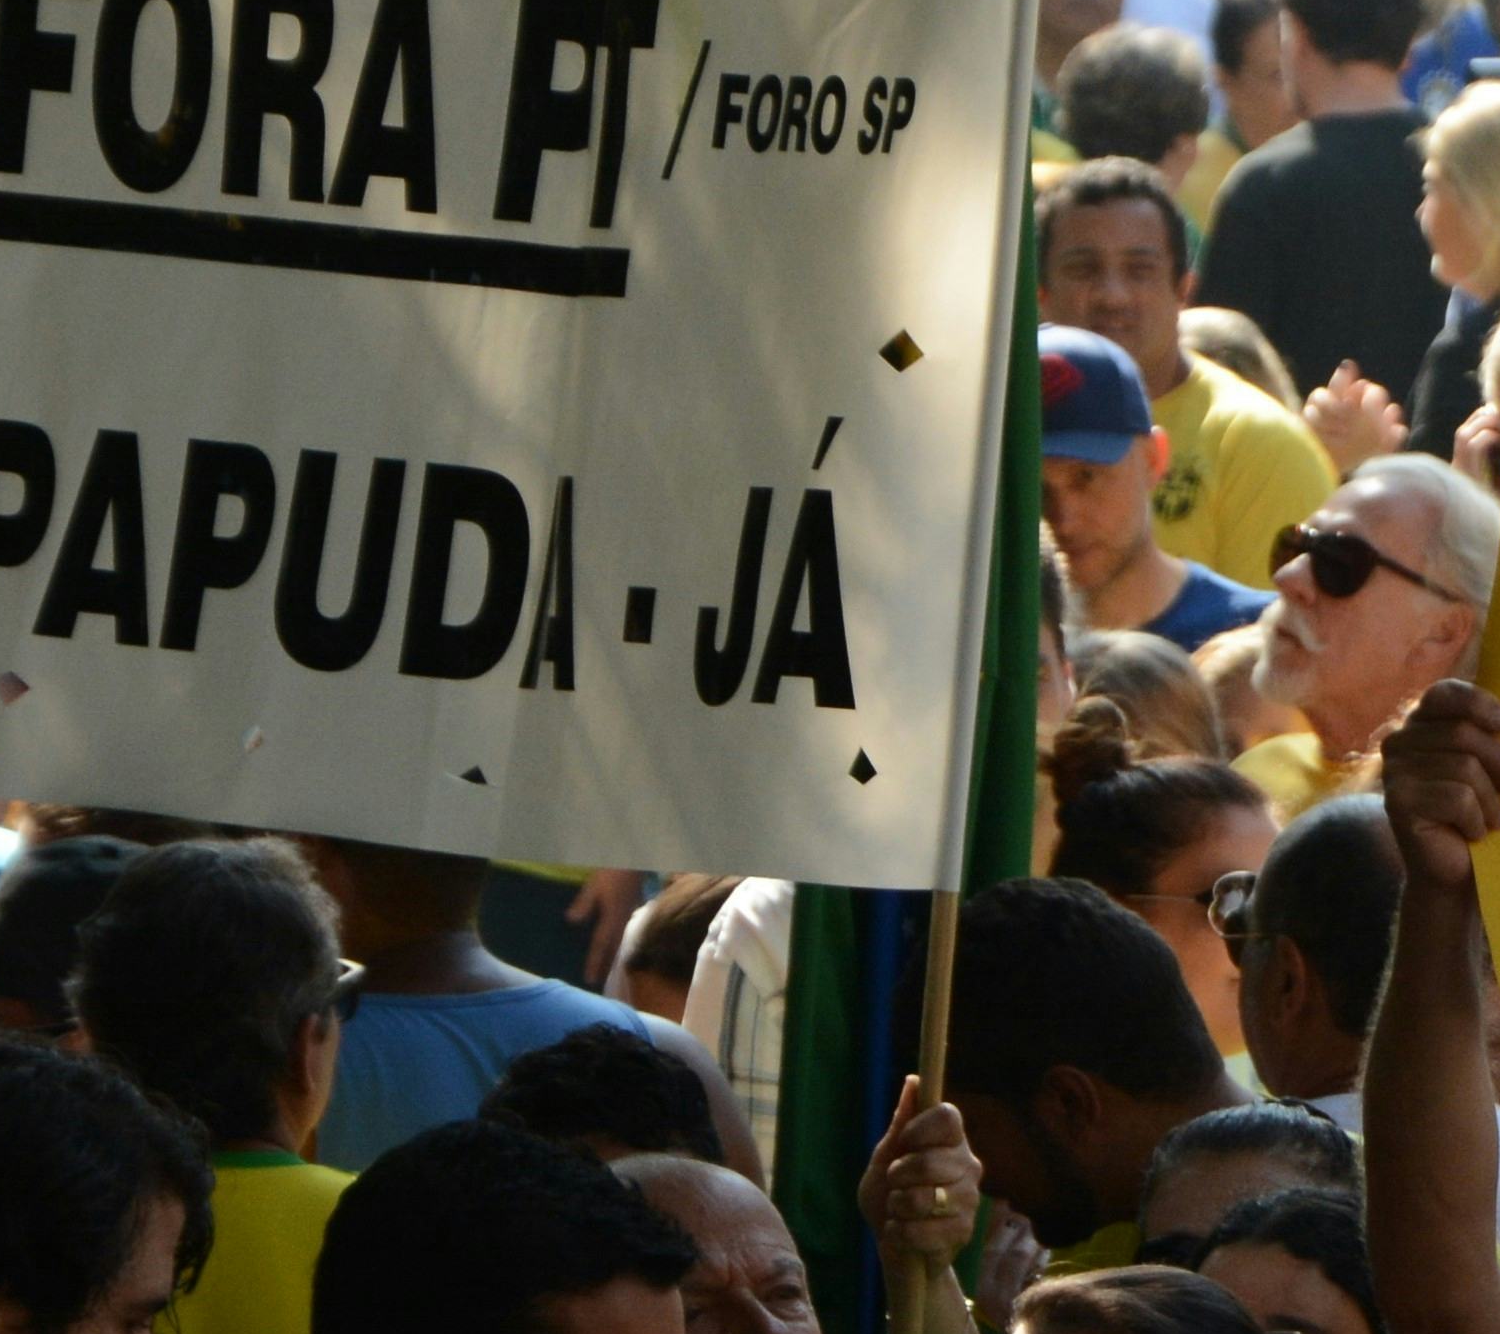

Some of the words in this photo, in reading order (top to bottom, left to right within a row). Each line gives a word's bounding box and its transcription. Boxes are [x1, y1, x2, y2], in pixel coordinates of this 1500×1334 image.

[711, 72, 847, 155] FORO
[857, 75, 917, 156] SP
[693, 415, 857, 711] JÁ
